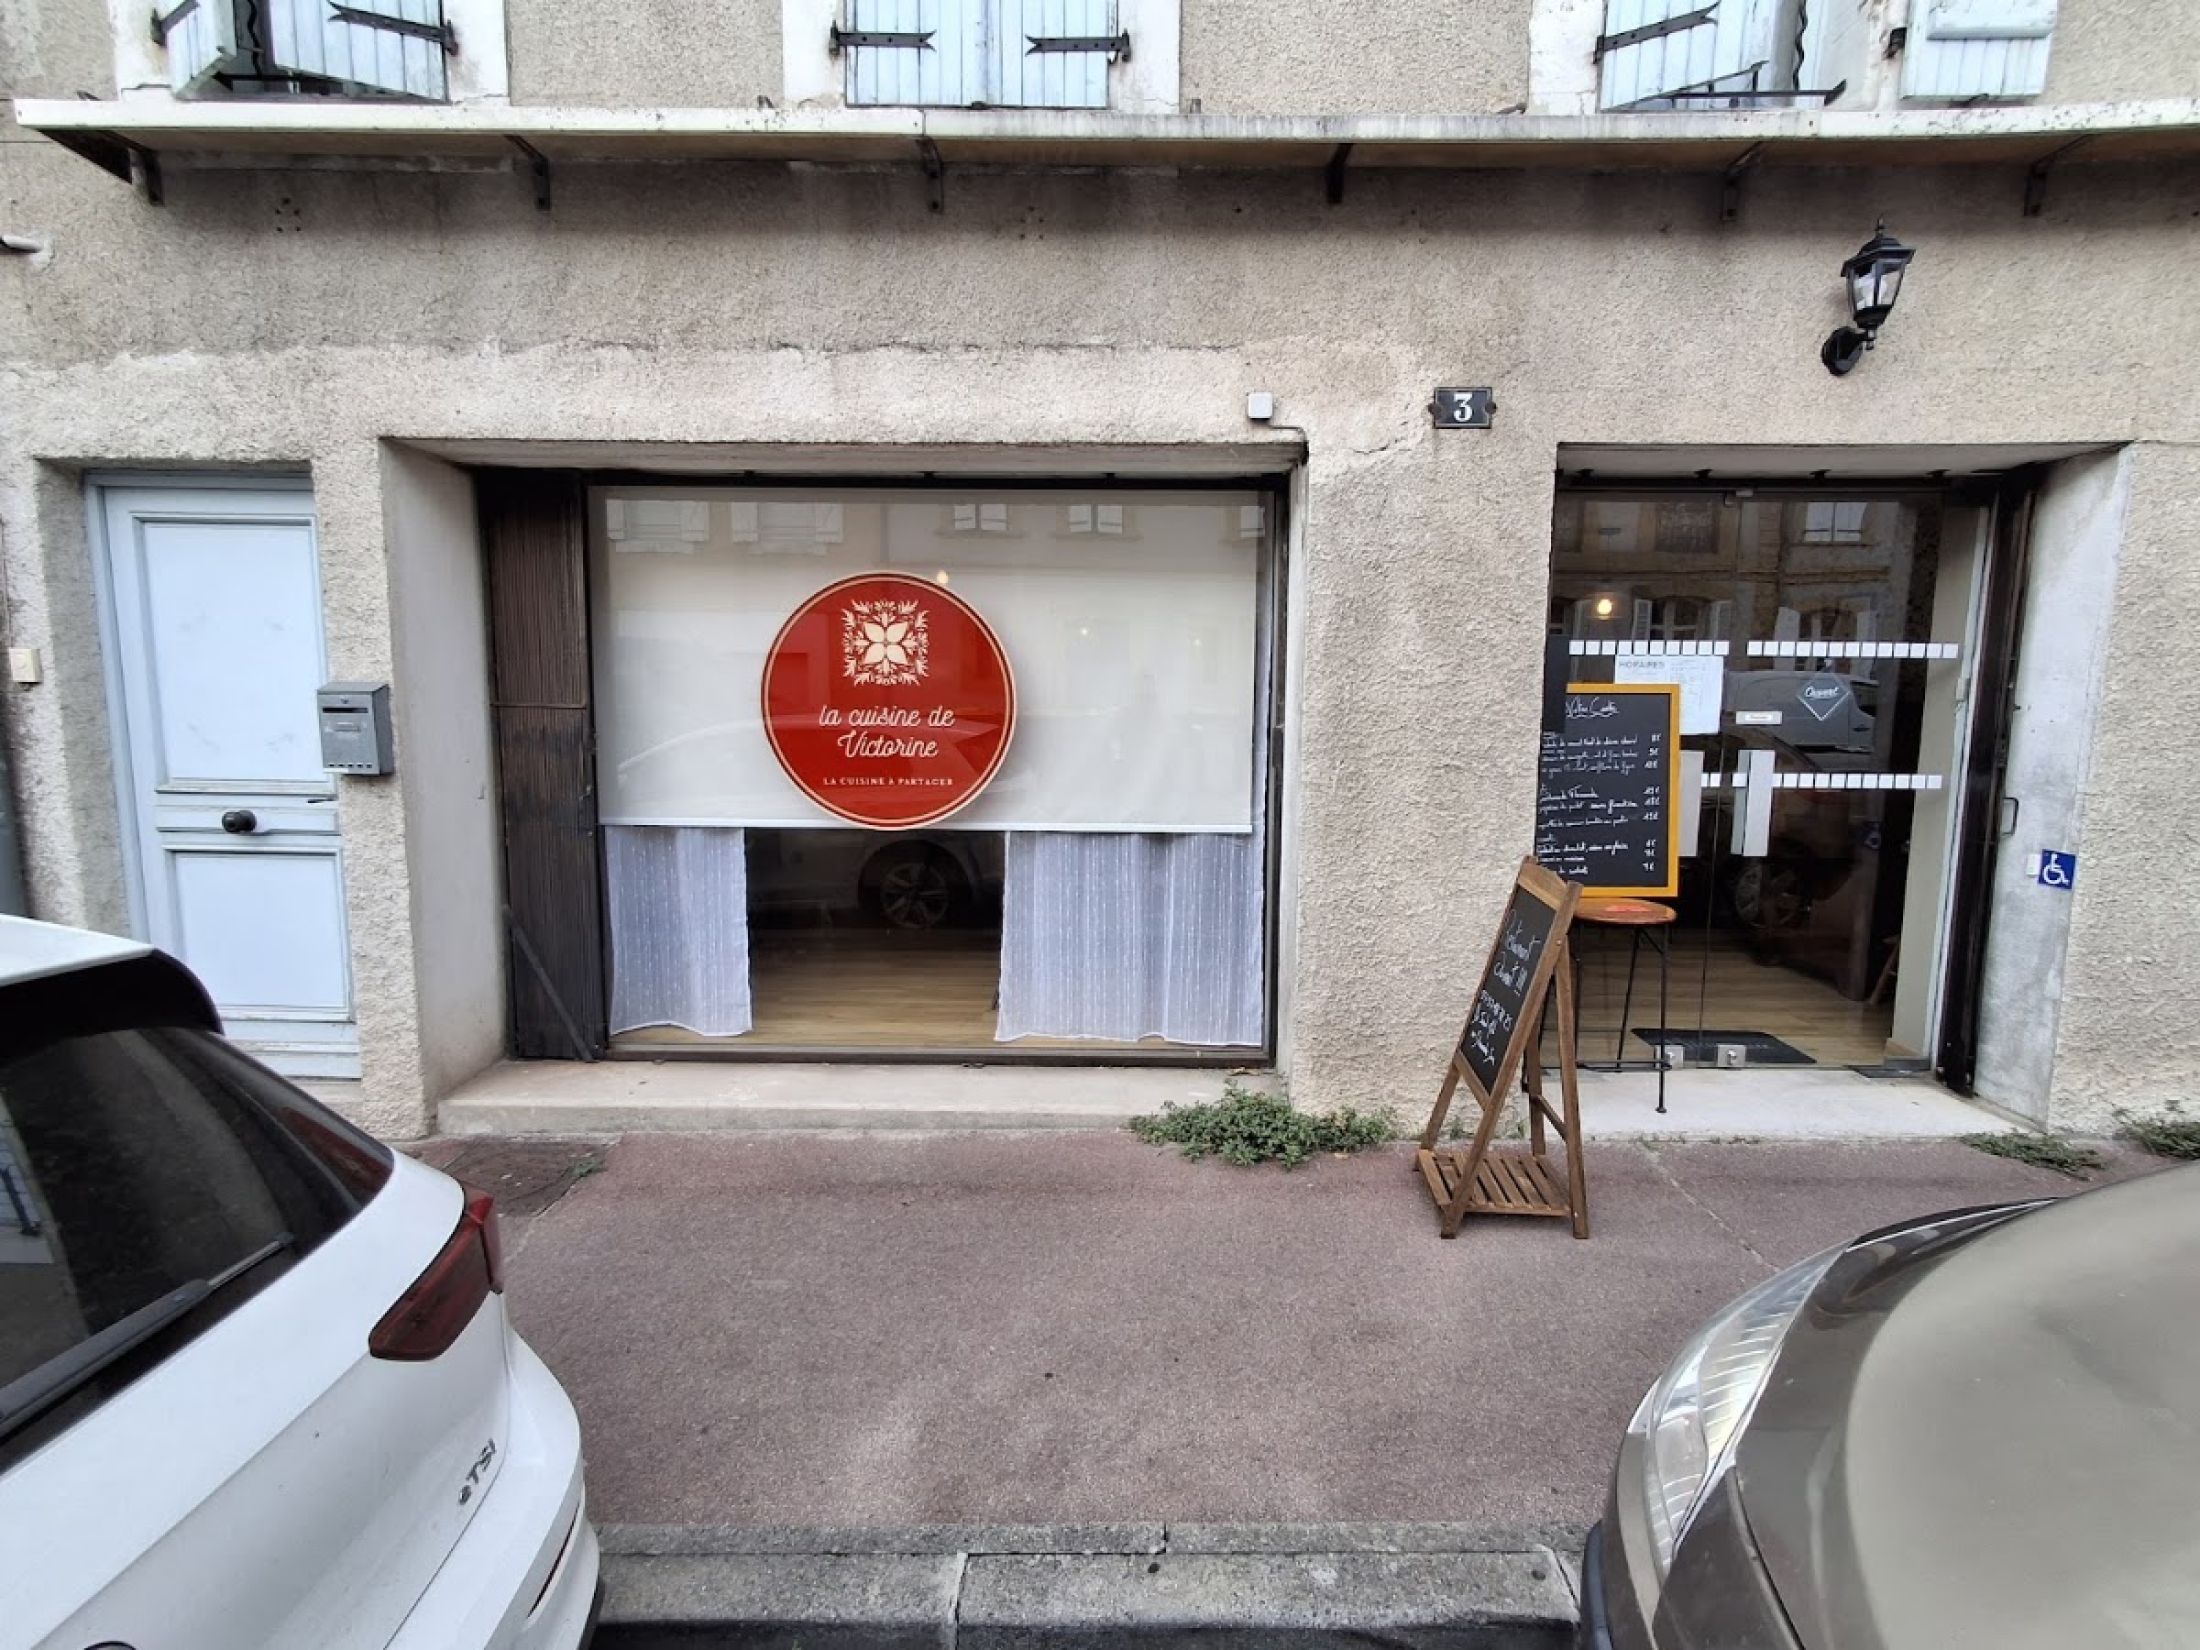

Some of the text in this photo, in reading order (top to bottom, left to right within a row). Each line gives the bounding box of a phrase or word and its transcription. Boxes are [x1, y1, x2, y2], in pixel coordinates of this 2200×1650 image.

[1453, 392, 1474, 423] 3
[819, 704, 955, 727] la cuisine de
[837, 729, 939, 758] Victorine
[823, 777, 837, 786] LA
[841, 777, 884, 786] CUISINE
[900, 777, 954, 786] PARTAGER
[457, 1438, 496, 1505] eTSI
